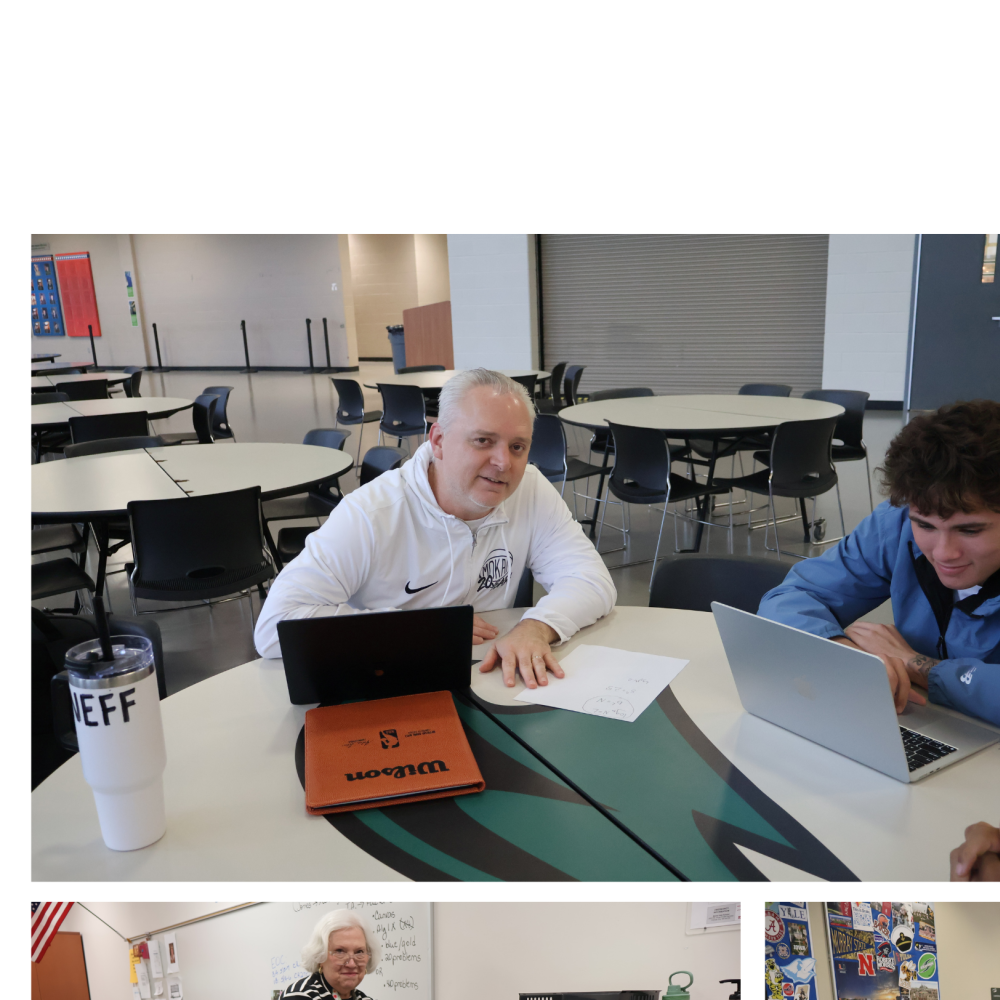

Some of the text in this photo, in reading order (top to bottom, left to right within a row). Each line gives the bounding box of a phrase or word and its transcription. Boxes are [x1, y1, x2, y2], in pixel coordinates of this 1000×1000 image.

[73, 687, 136, 727] NEFF
[344, 760, 450, 782] Wilson
[831, 927, 867, 954] MURRAY STATE
[858, 954, 875, 976] N
